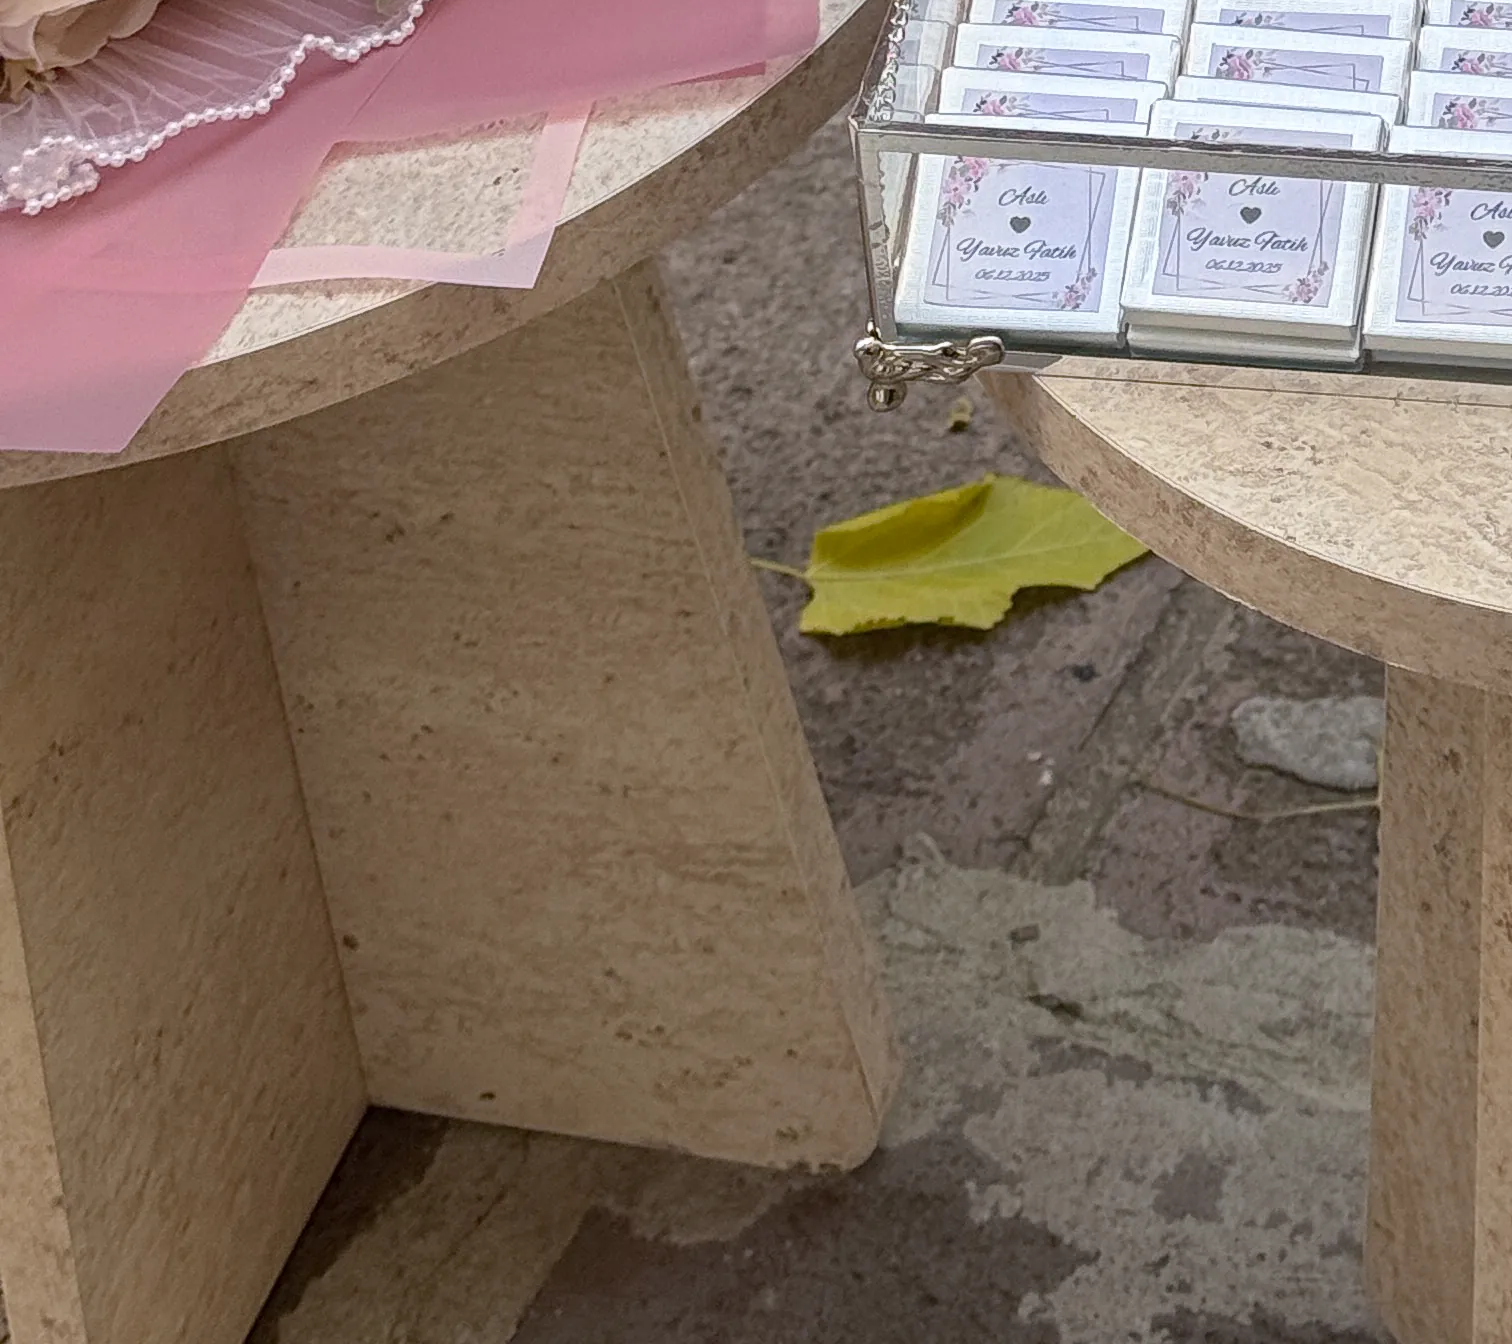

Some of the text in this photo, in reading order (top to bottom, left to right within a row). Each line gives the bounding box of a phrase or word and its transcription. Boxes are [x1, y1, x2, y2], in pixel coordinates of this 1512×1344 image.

[956, 237, 1077, 262] Yavuz Fatih
[1186, 227, 1309, 252] Yavuz Fatih
[1429, 252, 1496, 277] Yavuz
